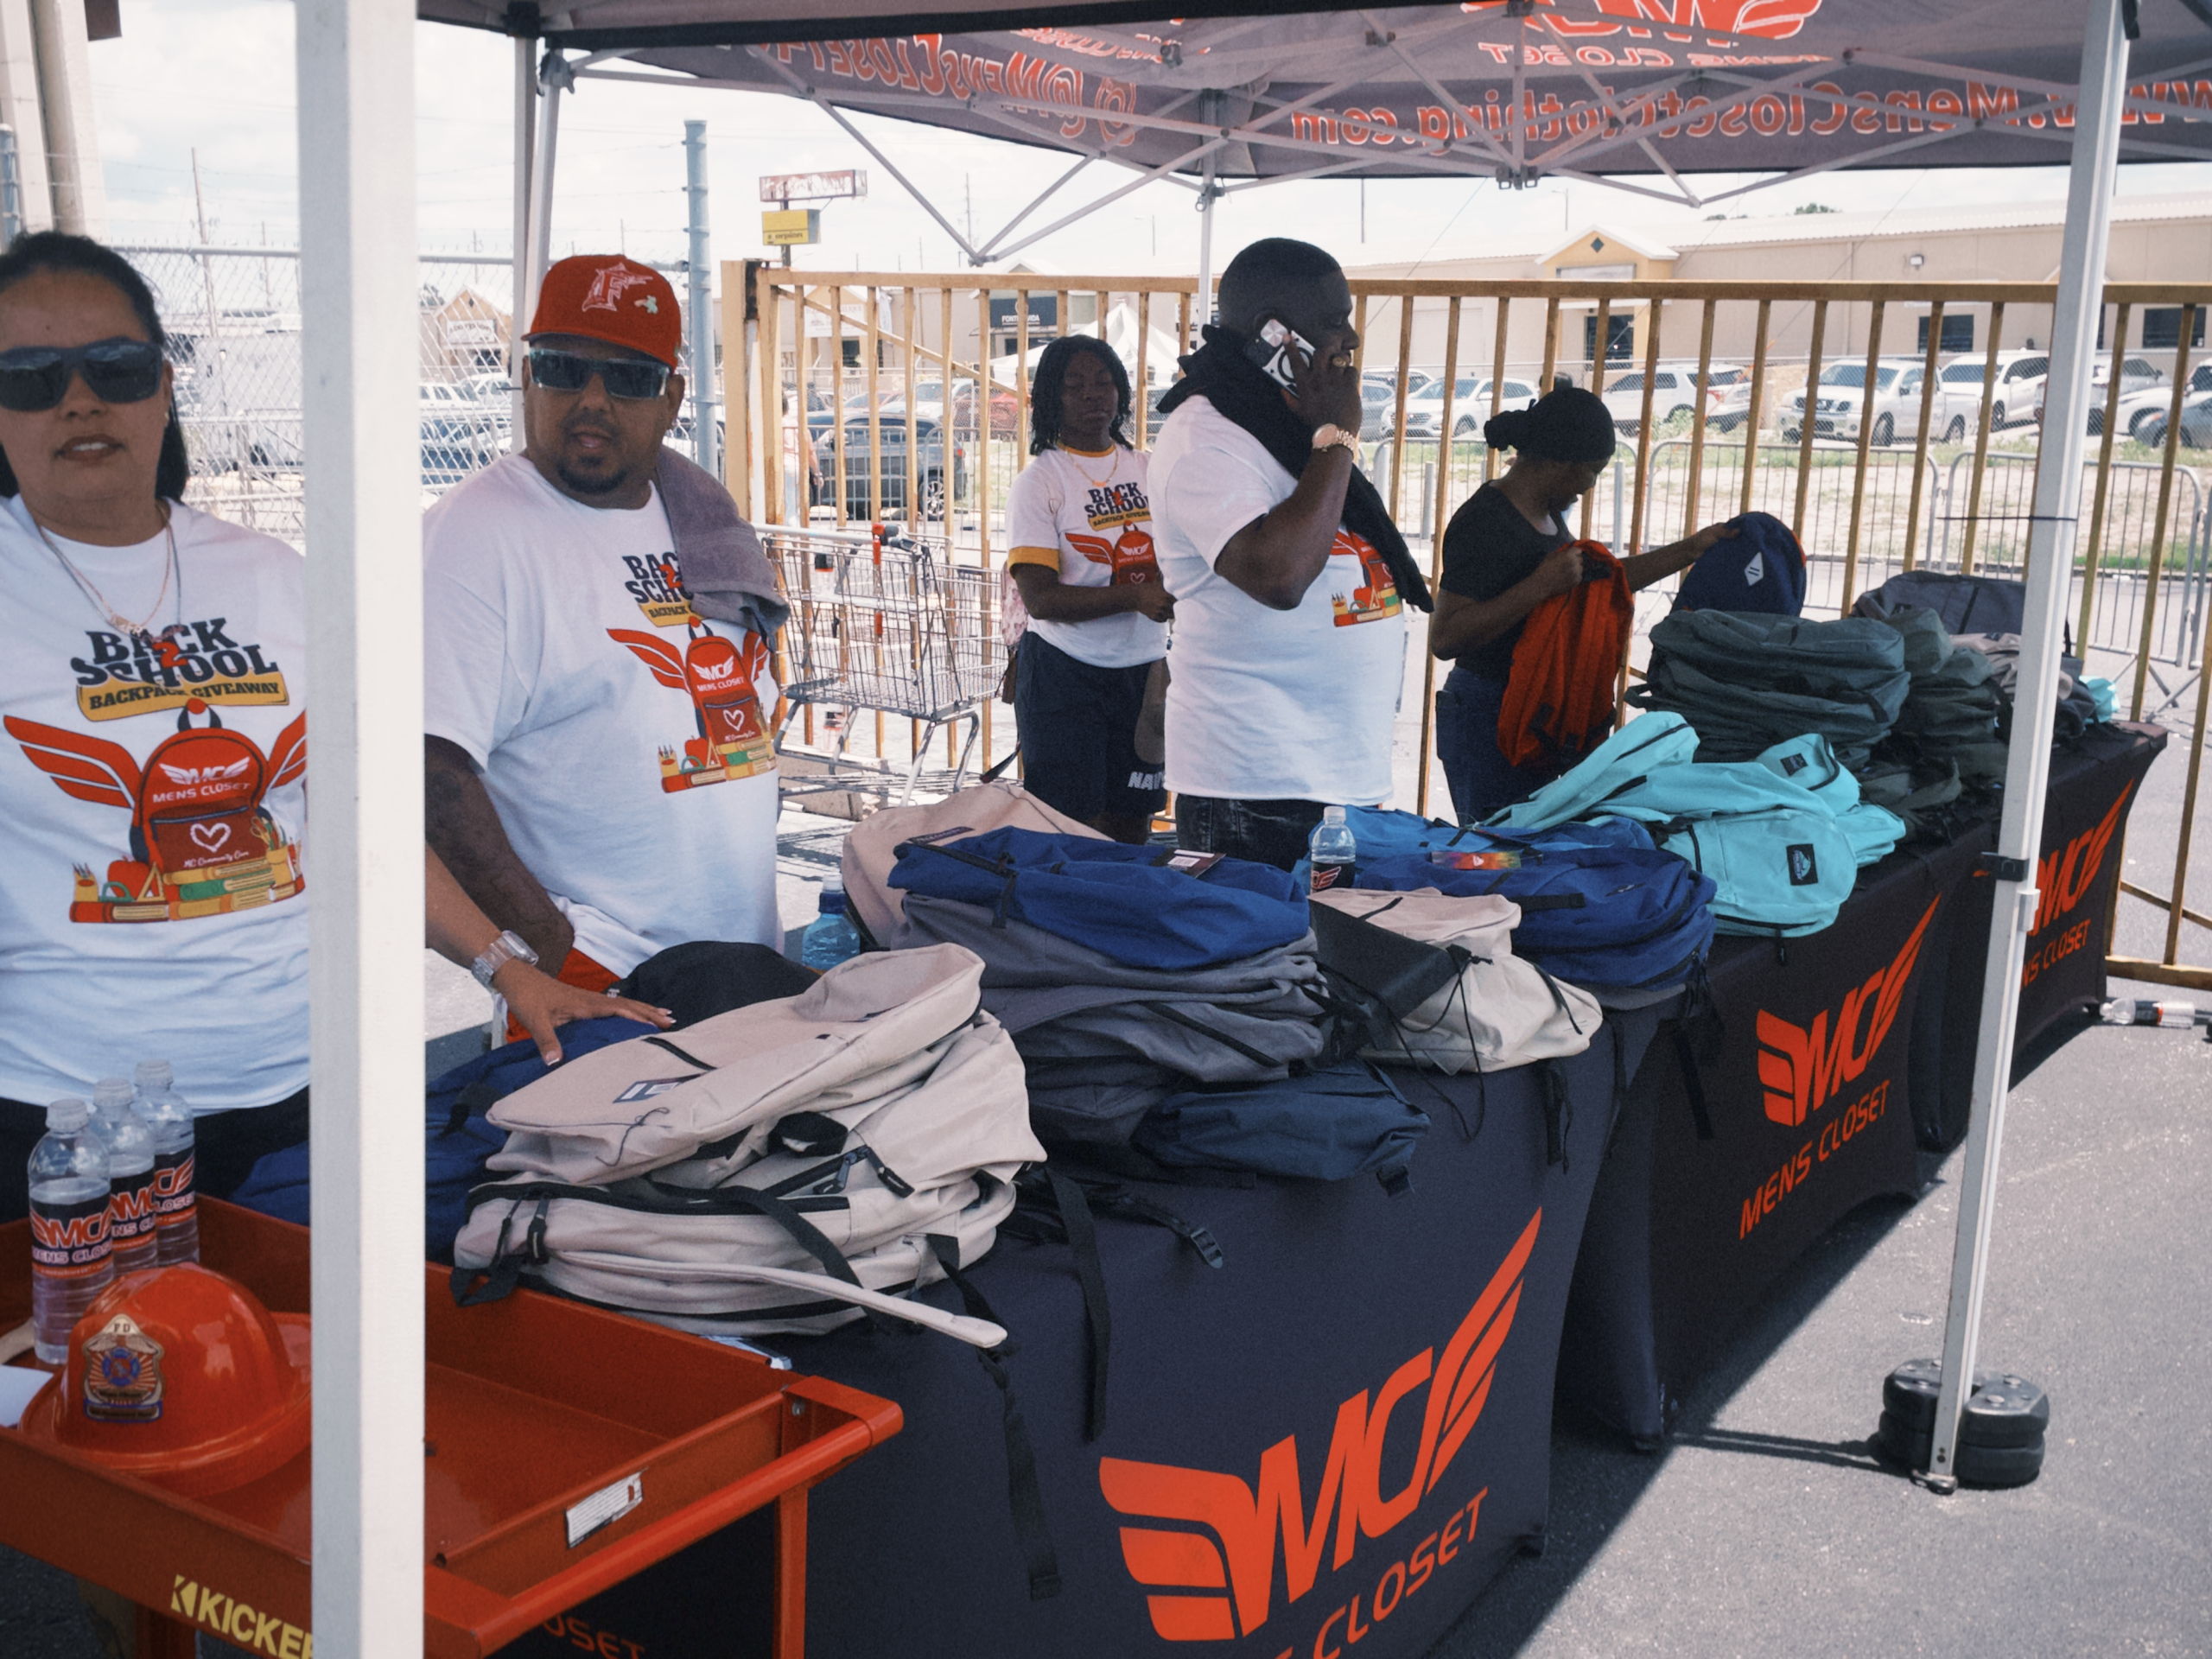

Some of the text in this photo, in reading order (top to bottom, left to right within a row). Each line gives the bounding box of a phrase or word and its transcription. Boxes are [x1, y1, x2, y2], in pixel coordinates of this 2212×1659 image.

[1088, 482, 1141, 503] BACK
[1112, 491, 1124, 506] 2
[622, 552, 683, 580] BAC
[659, 563, 681, 589] 2
[648, 606, 689, 618] BACKPACK
[85, 618, 238, 664] BACK
[71, 645, 279, 687] SCHOOL
[152, 641, 188, 669] 2
[191, 683, 280, 697] GIVEAWAY
[696, 677, 745, 692] MENS CLOSET
[153, 782, 251, 803] MENS CLOSET
[2020, 918, 2091, 992] NS CLOSET
[1739, 1079, 1890, 1240] MENS CLOSET
[1313, 1486, 1488, 1659] CLOSET
